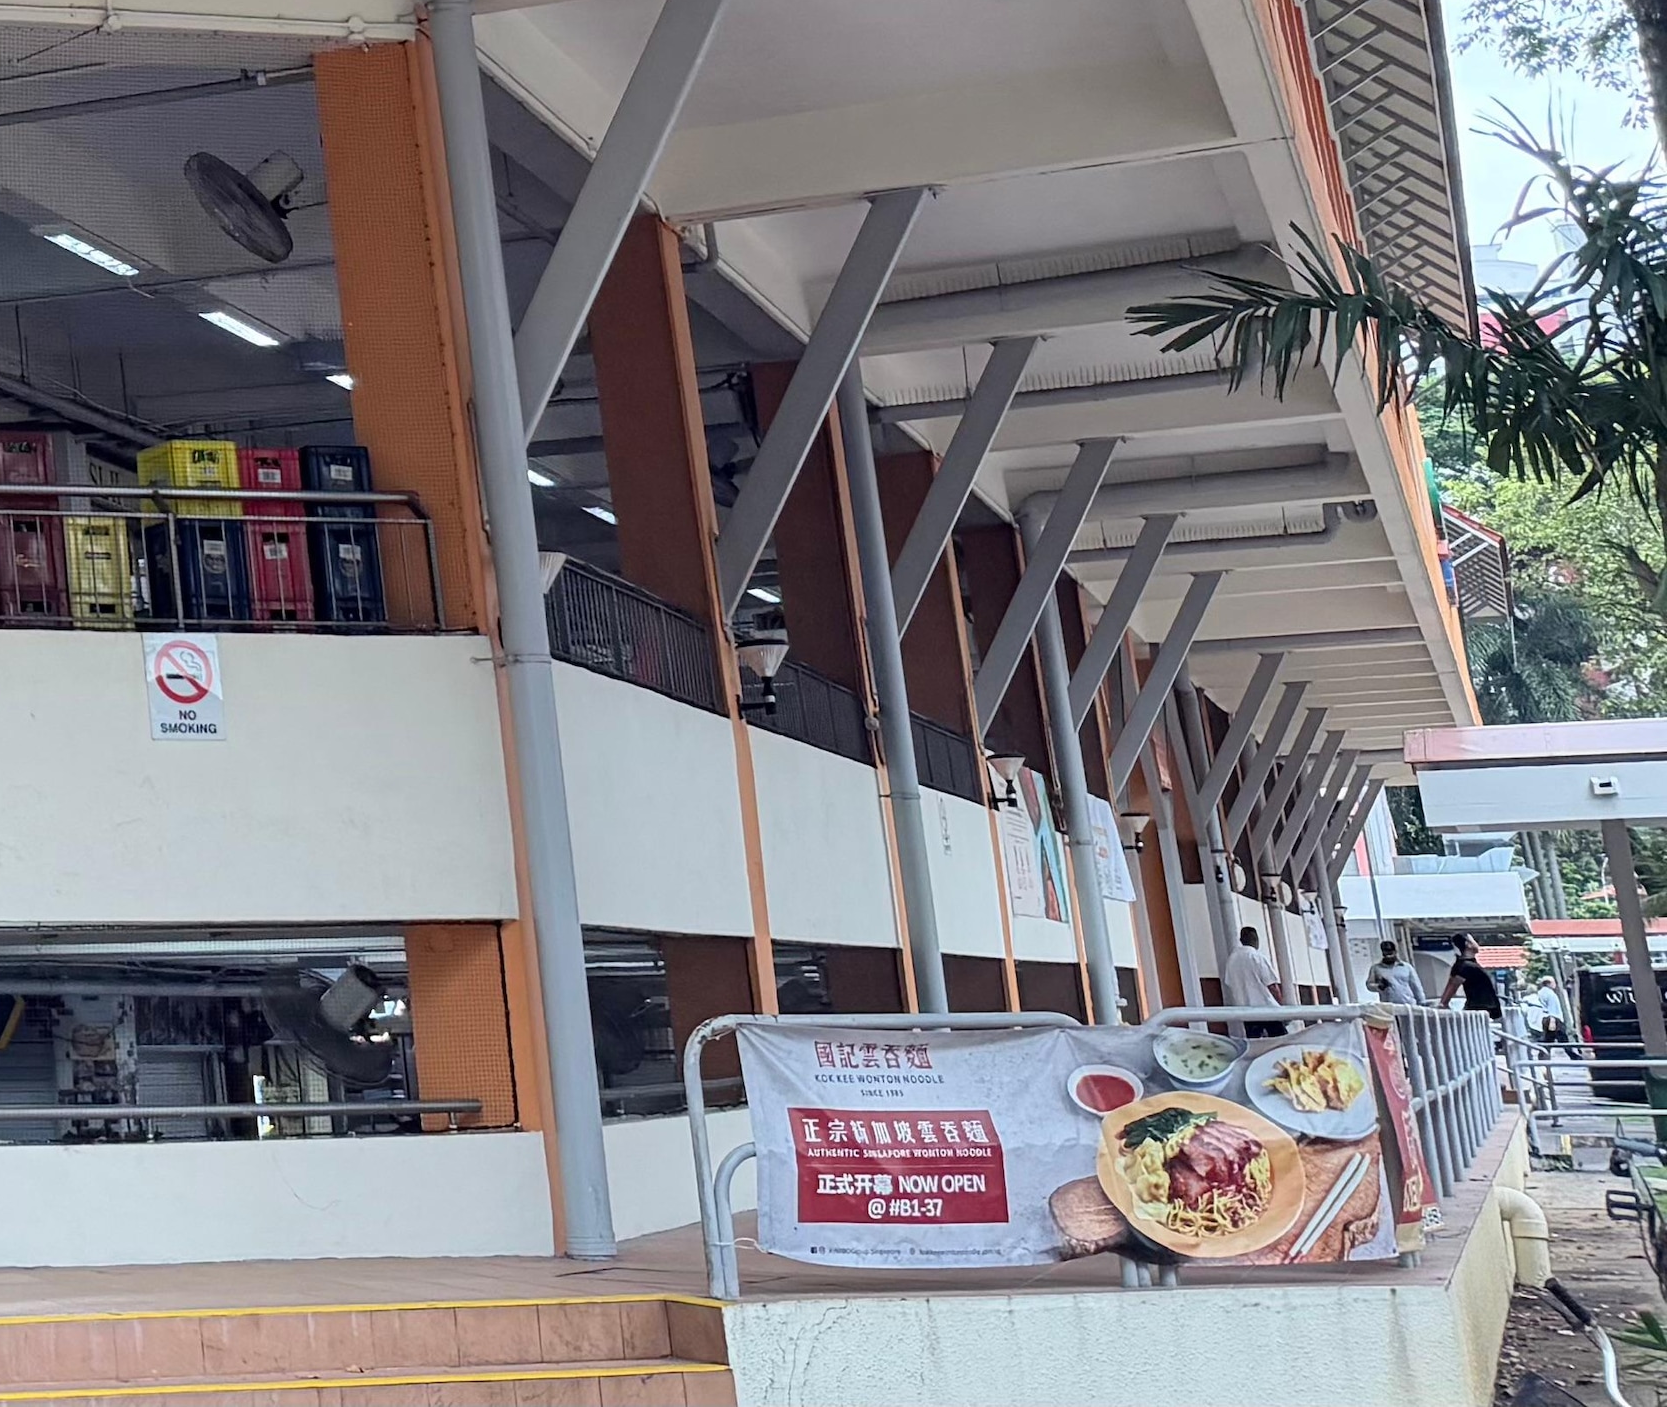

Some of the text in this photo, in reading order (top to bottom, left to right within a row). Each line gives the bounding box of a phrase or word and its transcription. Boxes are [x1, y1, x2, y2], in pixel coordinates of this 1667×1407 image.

[178, 709, 197, 721] NO
[160, 722, 218, 734] SMOKING
[814, 1074, 945, 1084] KOK KEE WONTON NOODLE
[807, 1147, 992, 1159] AUTHENTIC SINGAPORE WONTON NOODLE
[817, 1173, 986, 1196] 正式开幕 NOW OPEN
[867, 1198, 943, 1220] @ #B1-37
